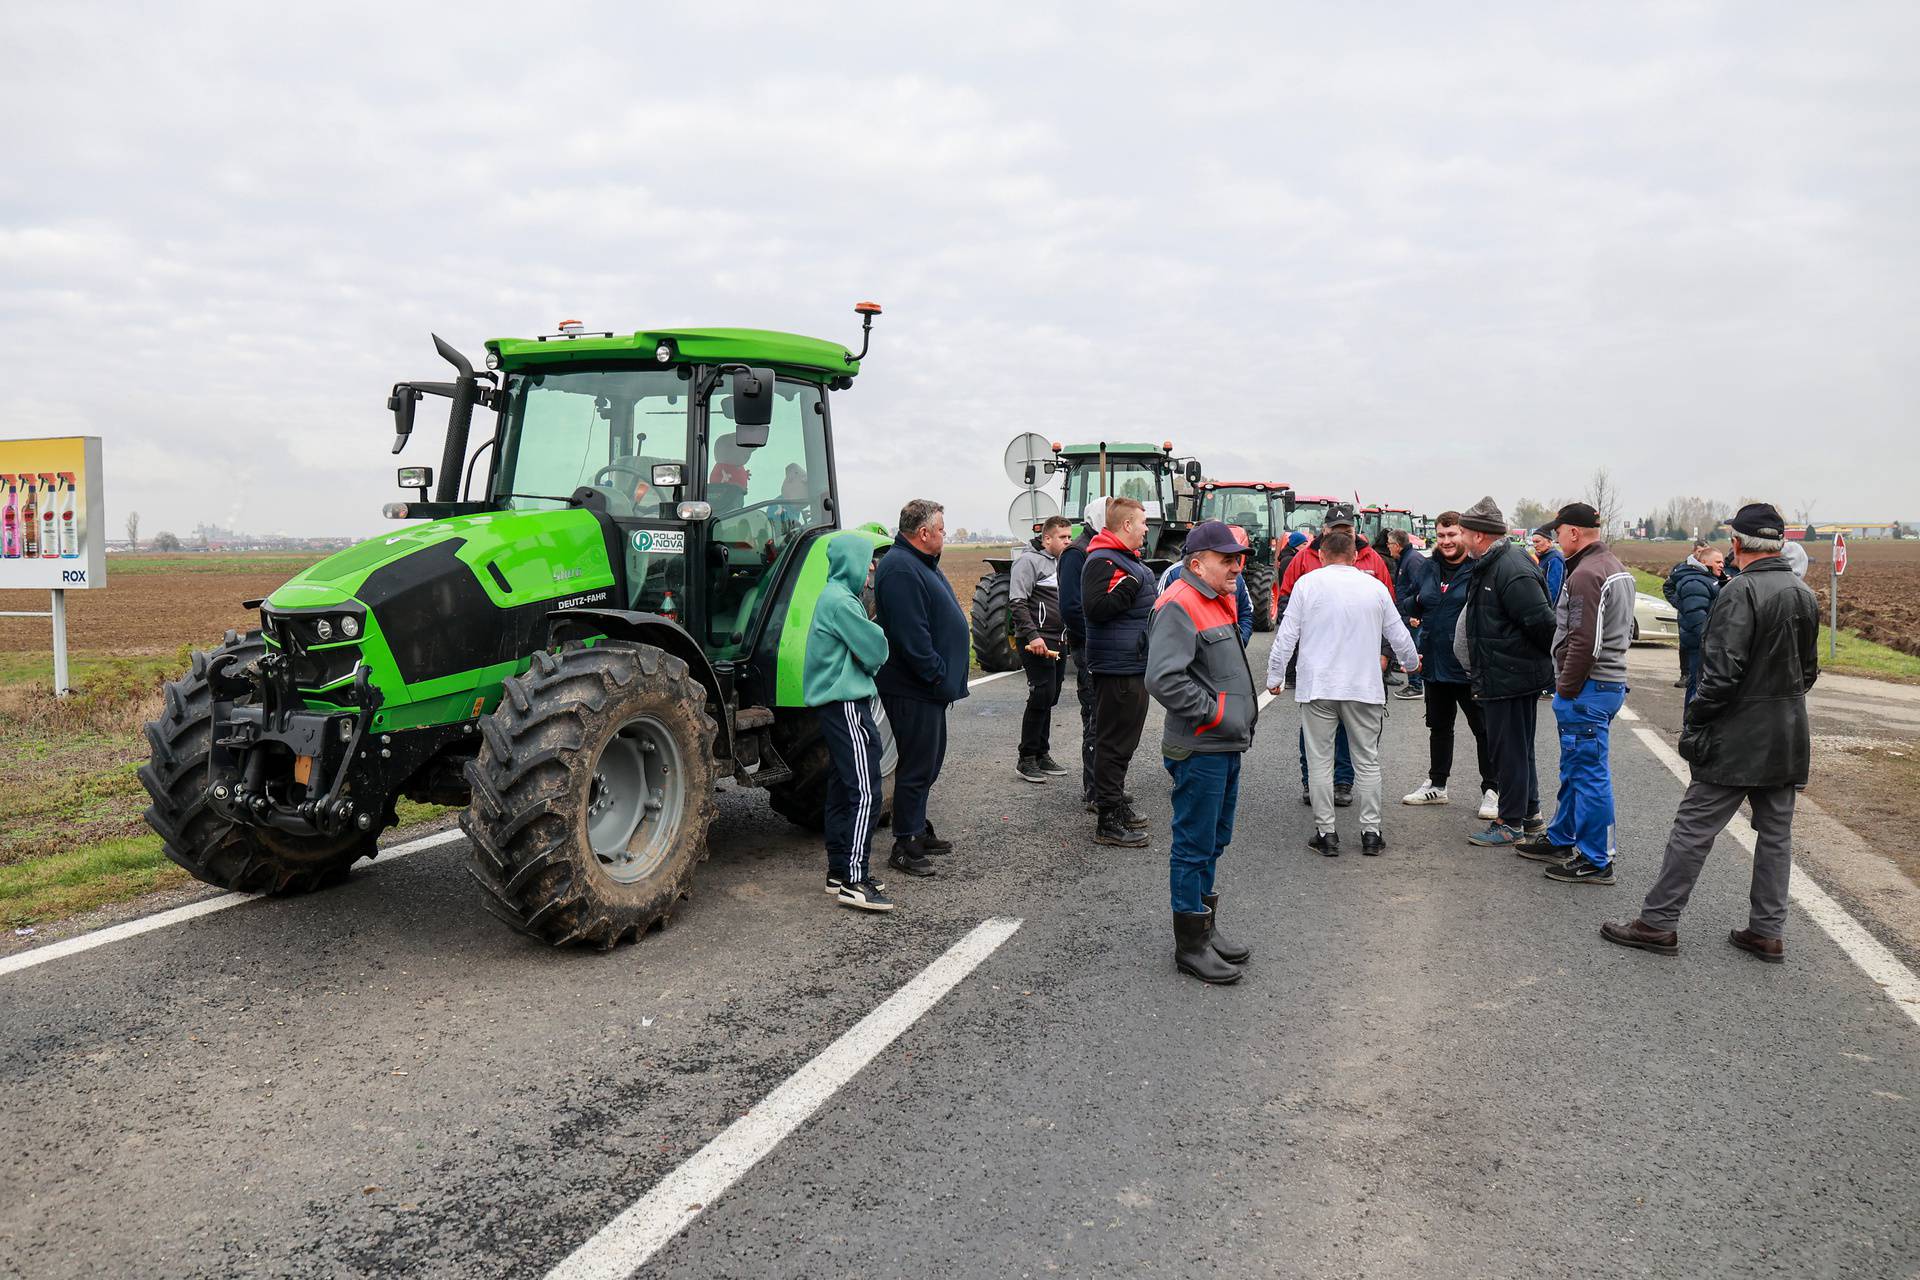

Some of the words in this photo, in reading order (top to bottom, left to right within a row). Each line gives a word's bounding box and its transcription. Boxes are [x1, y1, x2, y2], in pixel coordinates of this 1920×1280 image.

[653, 533, 684, 541] POLJO
[63, 570, 86, 583] ROX
[558, 592, 607, 610] DEUTZ-FAHR
